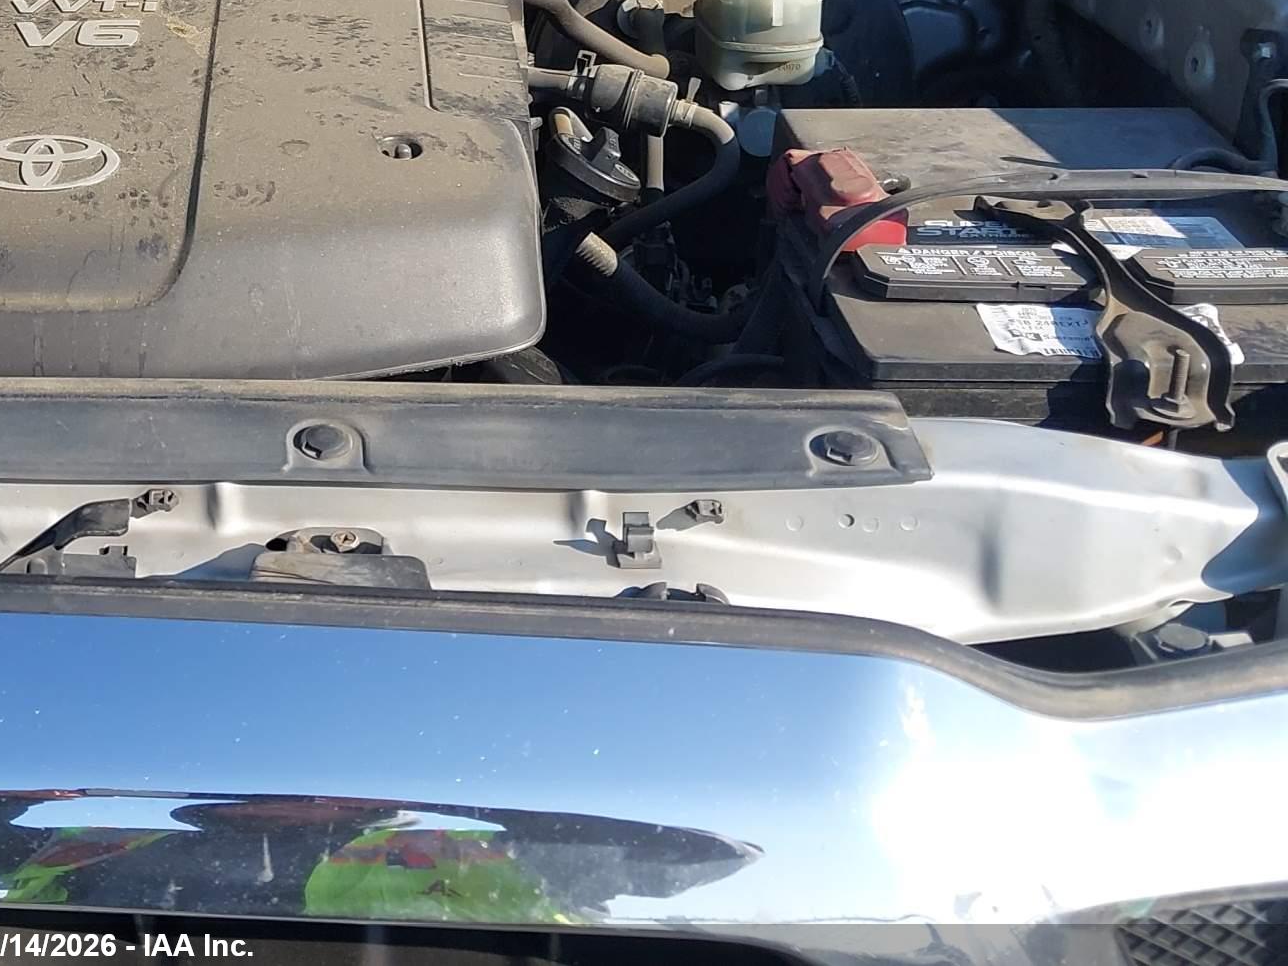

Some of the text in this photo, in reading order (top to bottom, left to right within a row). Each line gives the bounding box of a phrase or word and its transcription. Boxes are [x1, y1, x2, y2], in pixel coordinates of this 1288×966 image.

[14, 19, 141, 47] V6
[912, 248, 971, 256] DANGER
[982, 249, 1037, 257] POISON
